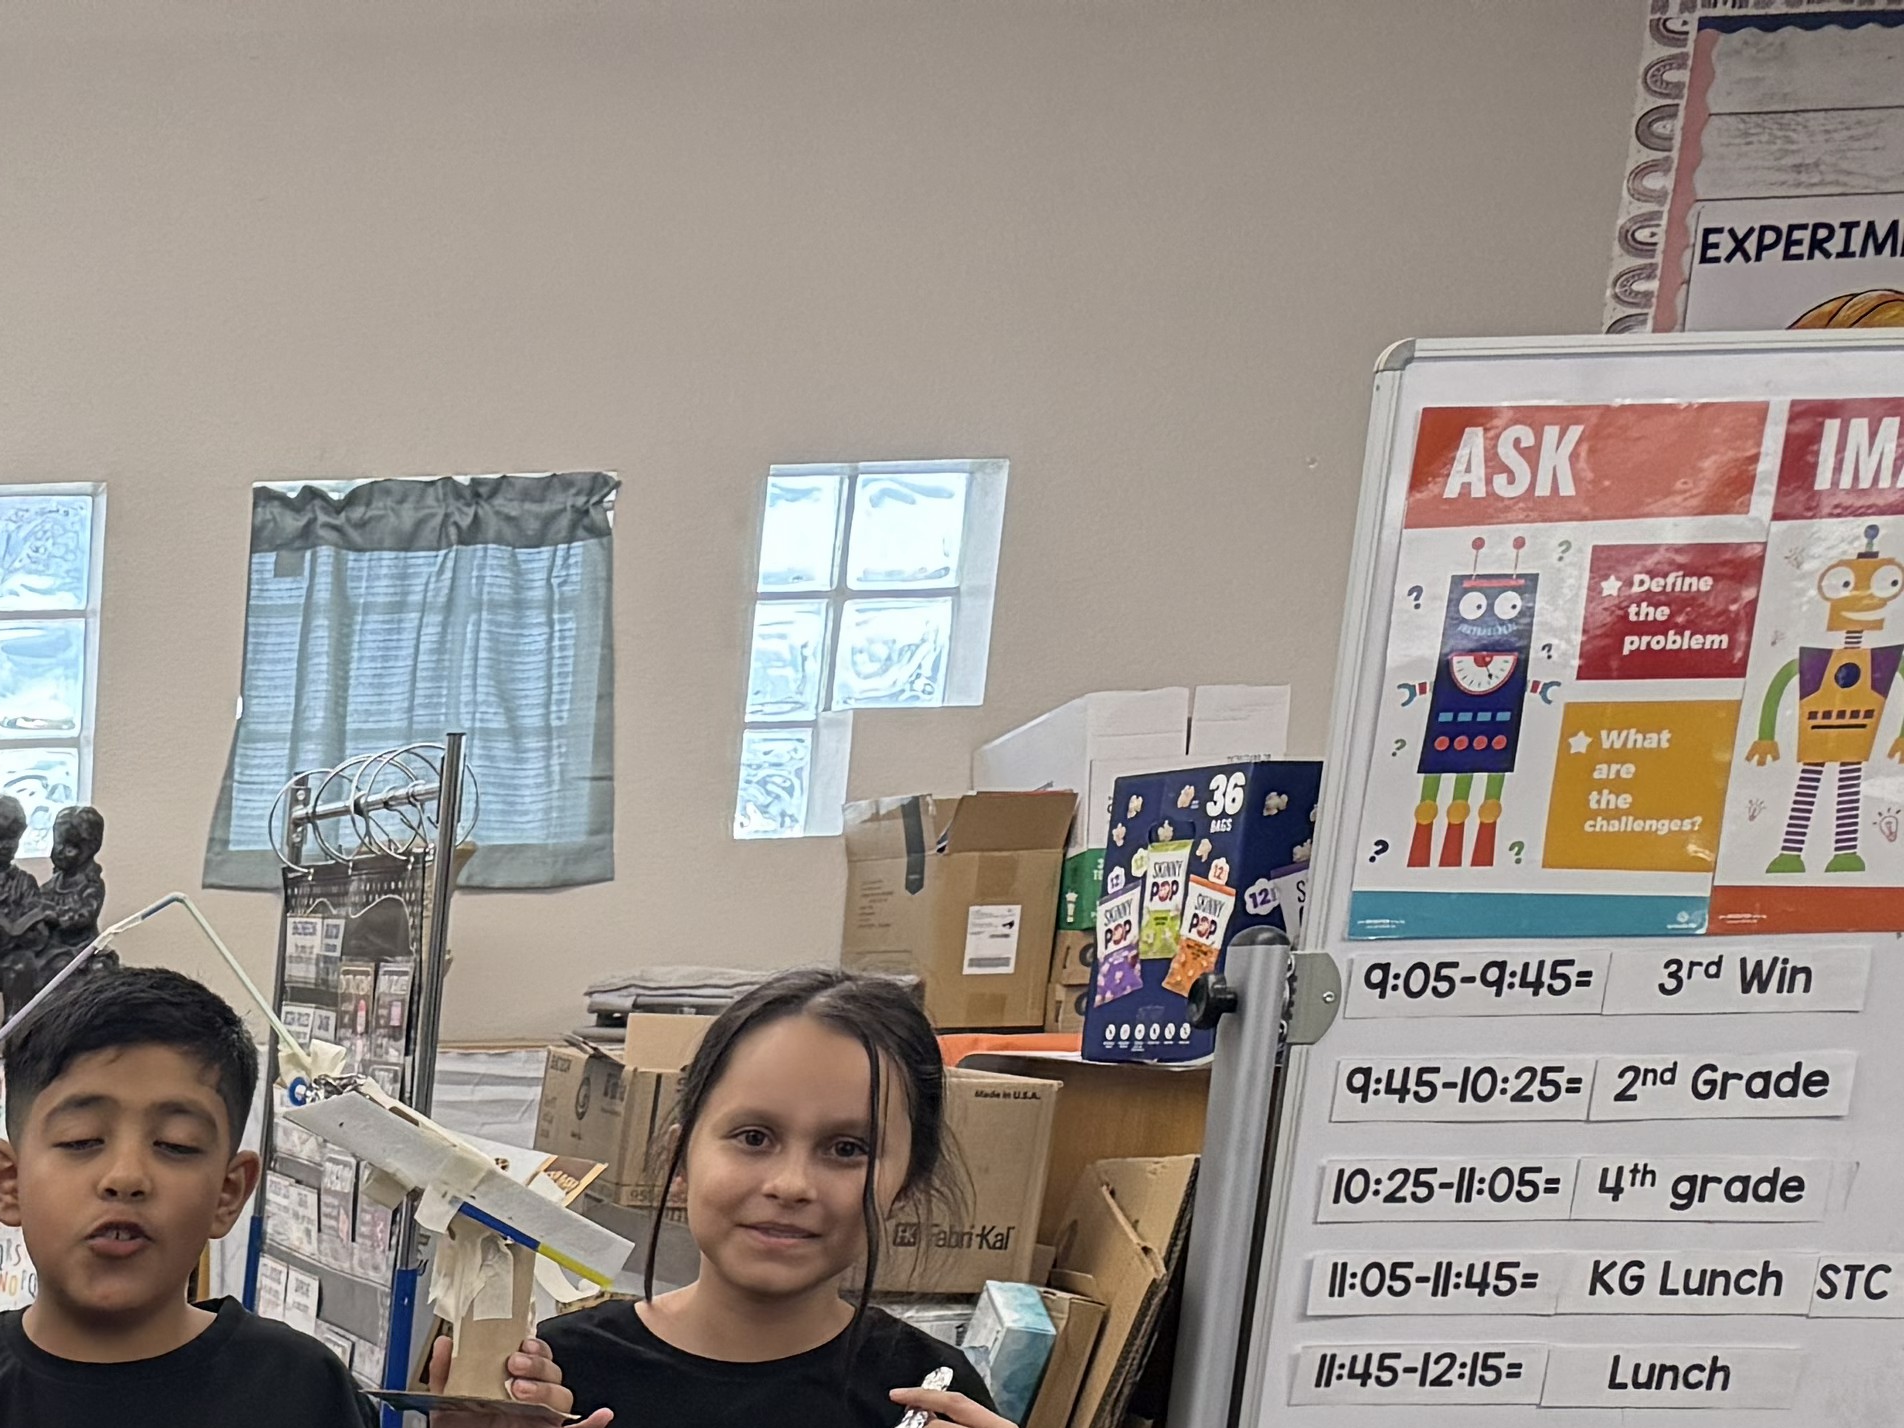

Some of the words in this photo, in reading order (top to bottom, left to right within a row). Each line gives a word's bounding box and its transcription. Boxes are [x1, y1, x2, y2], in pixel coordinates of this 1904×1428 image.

[1697, 219, 1904, 265] EXPERIM
[1441, 423, 1585, 499] ASK
[1813, 416, 1904, 491] IM
[1630, 573, 1713, 595] Define
[1627, 602, 1670, 622] the
[1622, 631, 1729, 656] problem
[1598, 728, 1672, 750] What
[1592, 761, 1635, 780] are
[1206, 772, 1245, 817] 36
[1588, 789, 1632, 810] the
[1583, 814, 1703, 835] challenges?
[1213, 864, 1224, 880] 12
[1150, 880, 1179, 902] POP
[1248, 888, 1271, 909] 12
[1104, 919, 1132, 950] POP
[1188, 912, 1217, 939] POP
[1362, 959, 1592, 999] 9:05-9:45=
[1657, 954, 1722, 995] 3rd
[1738, 955, 1813, 994] Win
[1344, 1065, 1581, 1104] 9:45-10:25=
[1612, 1061, 1677, 1102] 2nd
[1690, 1061, 1830, 1101] Grade
[1331, 1166, 1560, 1205] 10:25-11:05=
[1597, 1162, 1655, 1202] 4th
[1668, 1166, 1805, 1210] grade
[1327, 1260, 1537, 1298] 11:05-11:45=
[1587, 1259, 1645, 1296] KG
[1657, 1258, 1783, 1298] Lunch
[1813, 1263, 1891, 1302] STC
[1313, 1352, 1521, 1390] 11:45-12:15=
[1607, 1353, 1730, 1392] Lunch
